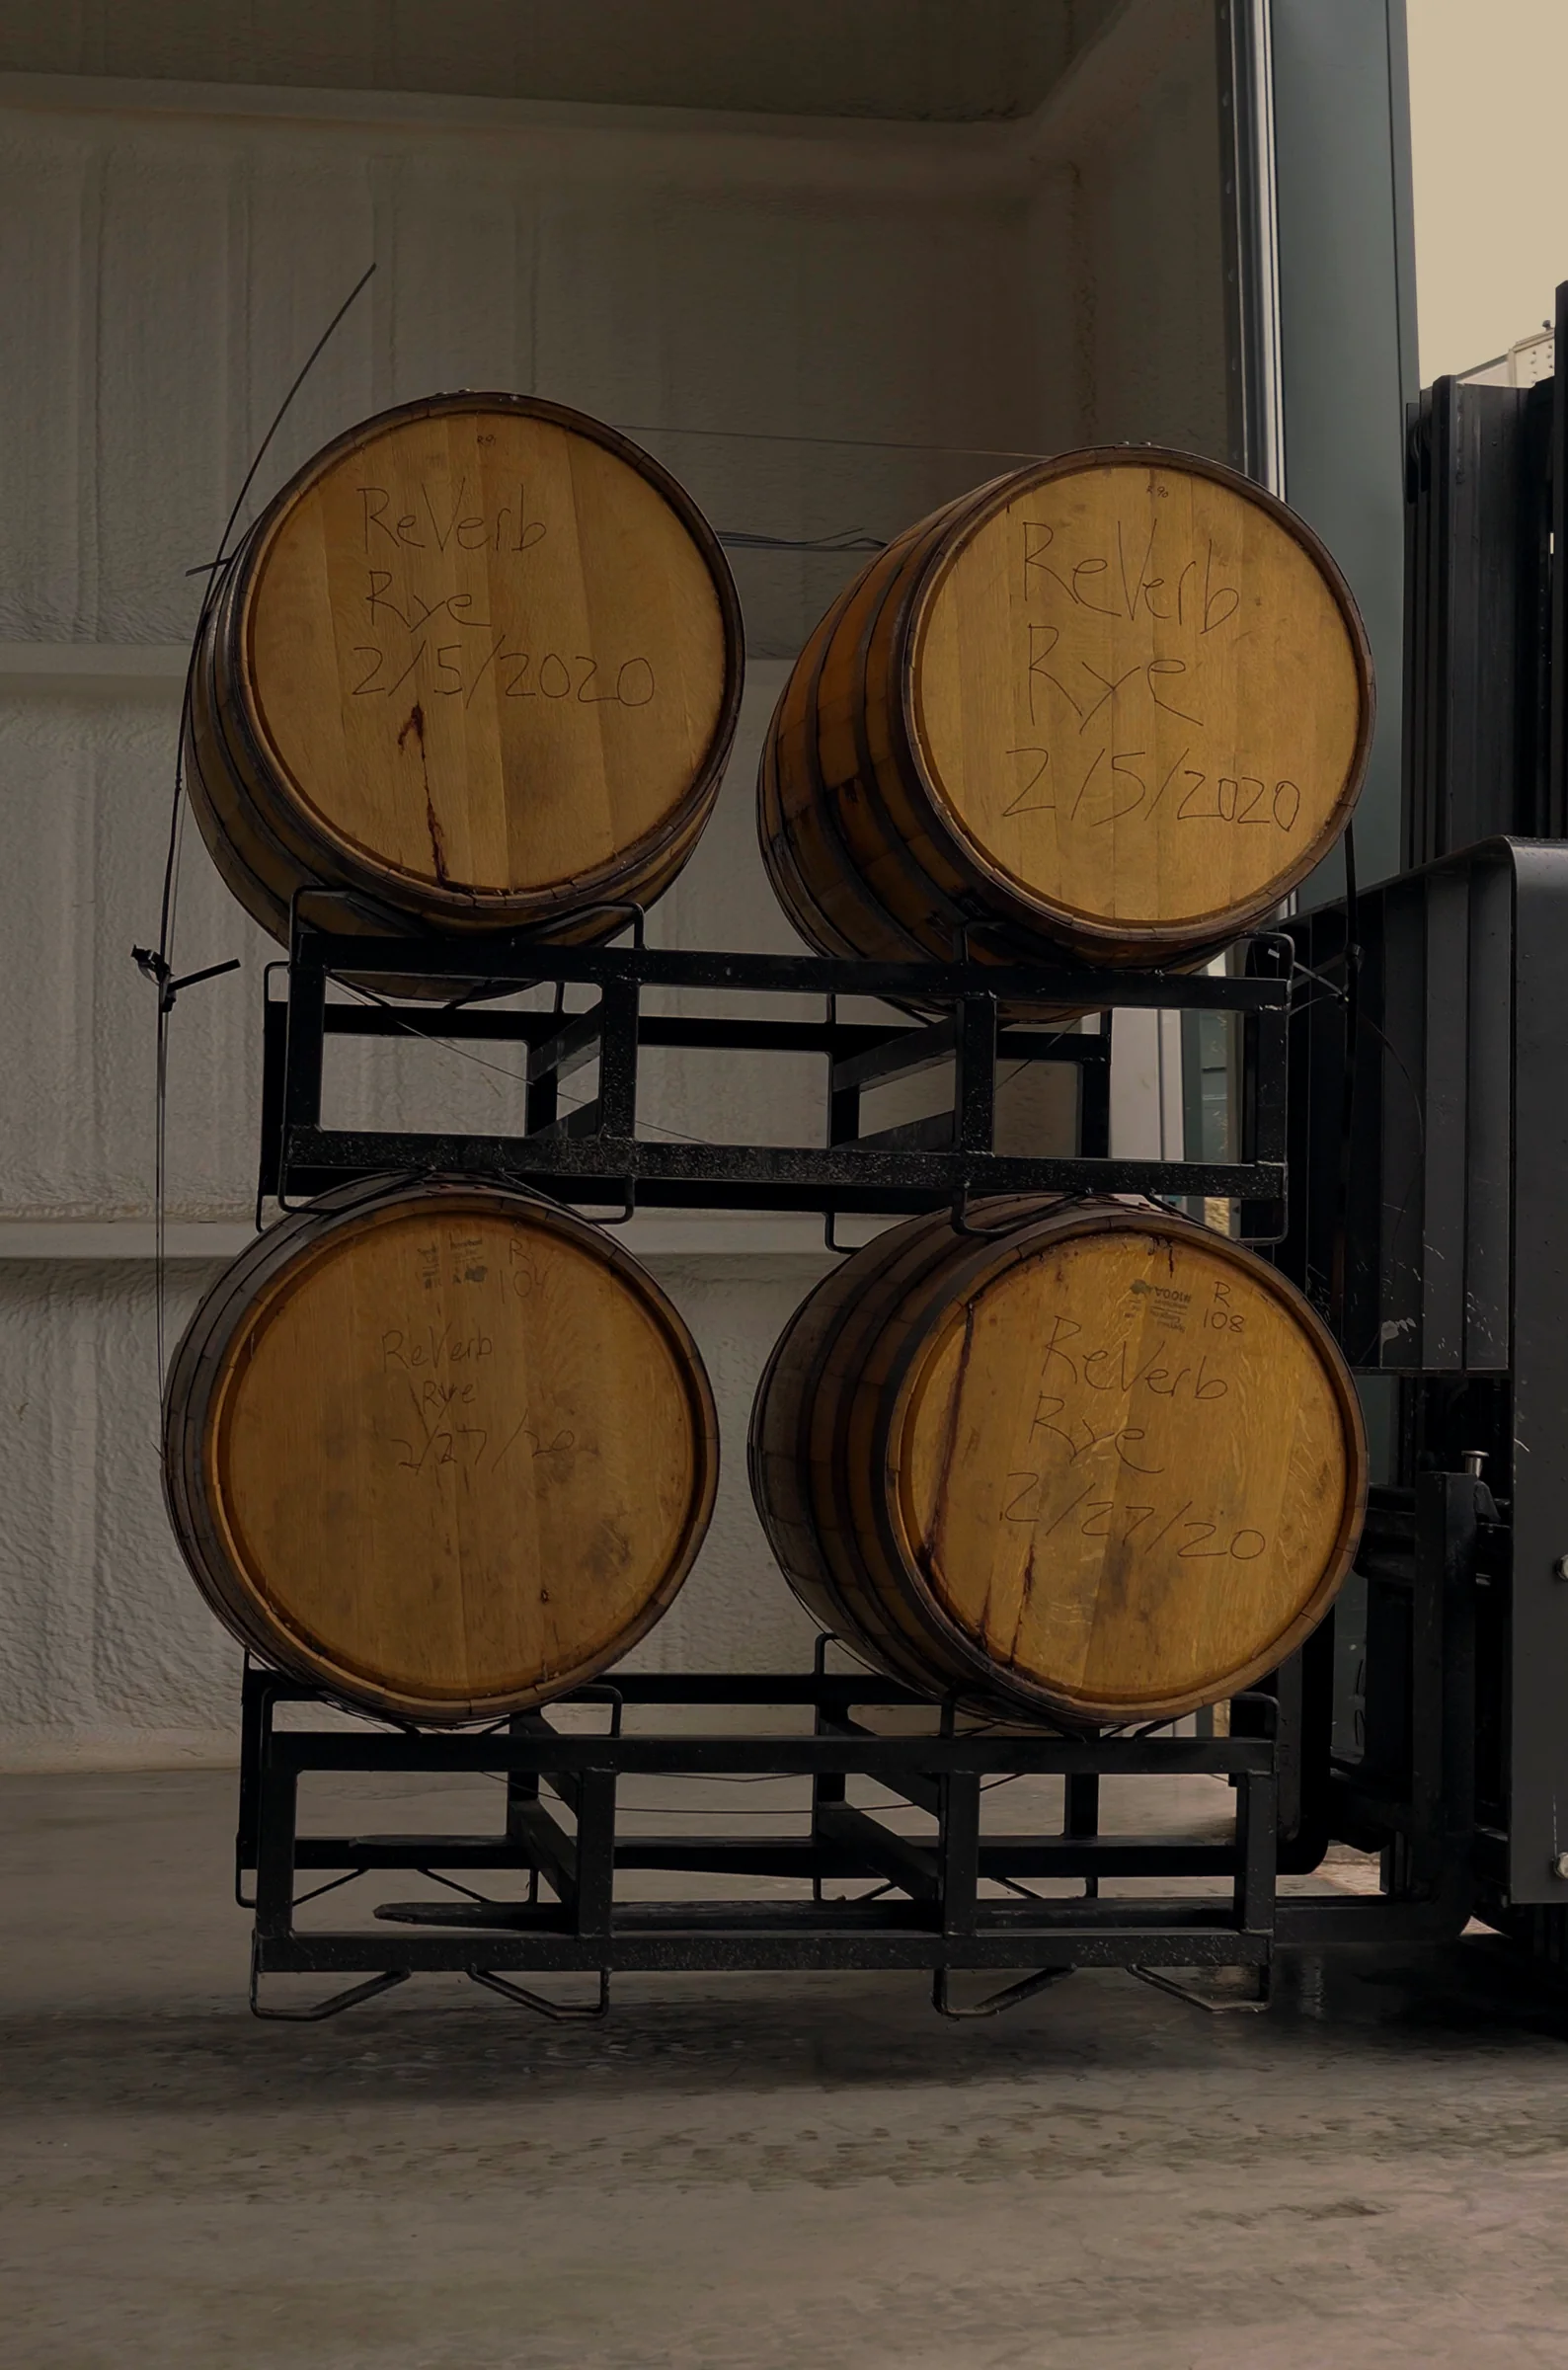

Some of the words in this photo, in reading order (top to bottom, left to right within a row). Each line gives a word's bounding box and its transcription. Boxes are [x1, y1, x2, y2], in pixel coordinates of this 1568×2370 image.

[365, 570, 493, 633] Rye
[352, 634, 656, 710] 2/5/2020
[1028, 622, 1205, 736] Rye
[1002, 748, 1300, 832] 2/5/2020
[1203, 1306, 1246, 1334] 108
[1214, 1281, 1231, 1308] R
[421, 1380, 476, 1420] Rye
[1028, 1389, 1165, 1473] Rye
[390, 1407, 576, 1476] 2/27/20
[1004, 1471, 1267, 1560] 2/27/20
